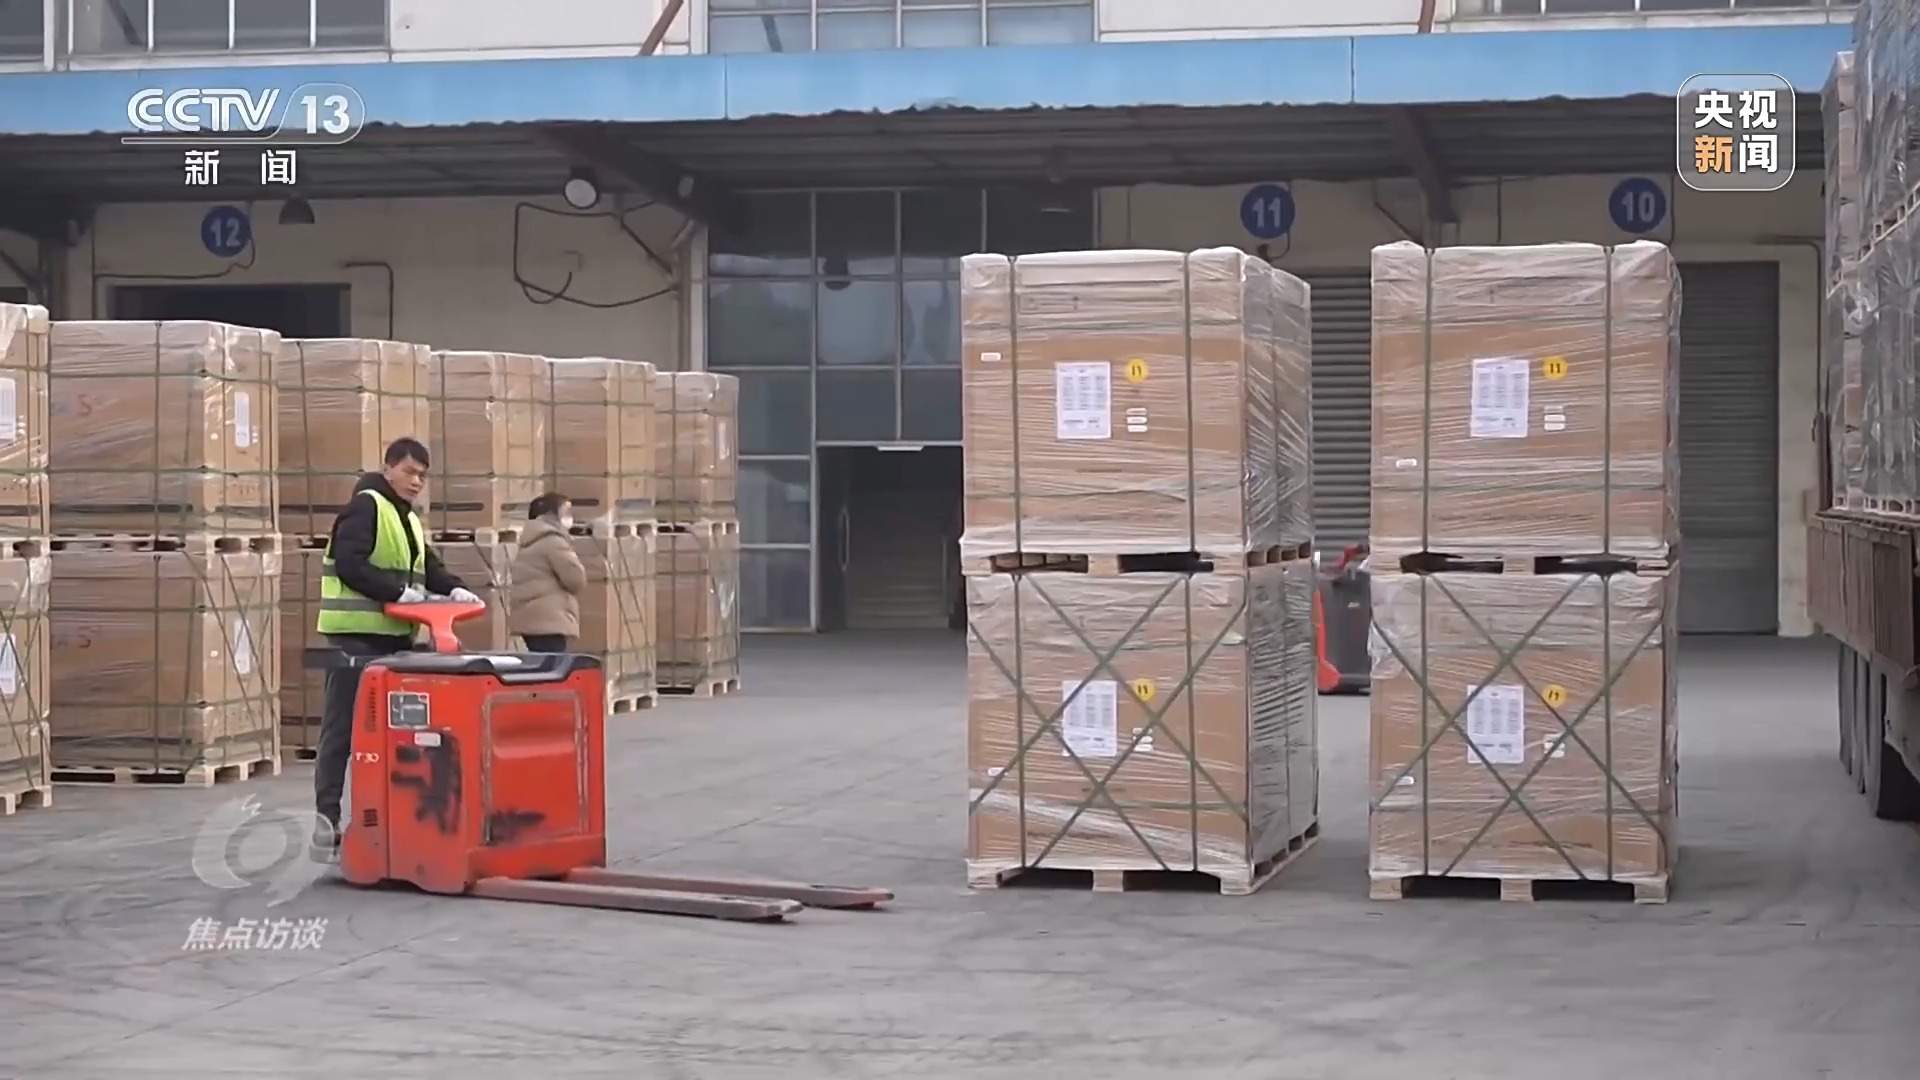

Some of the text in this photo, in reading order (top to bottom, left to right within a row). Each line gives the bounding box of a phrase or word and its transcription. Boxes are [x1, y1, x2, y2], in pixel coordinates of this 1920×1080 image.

[1252, 197, 1281, 228] 11
[1621, 191, 1656, 222] 10
[209, 217, 241, 248] 12
